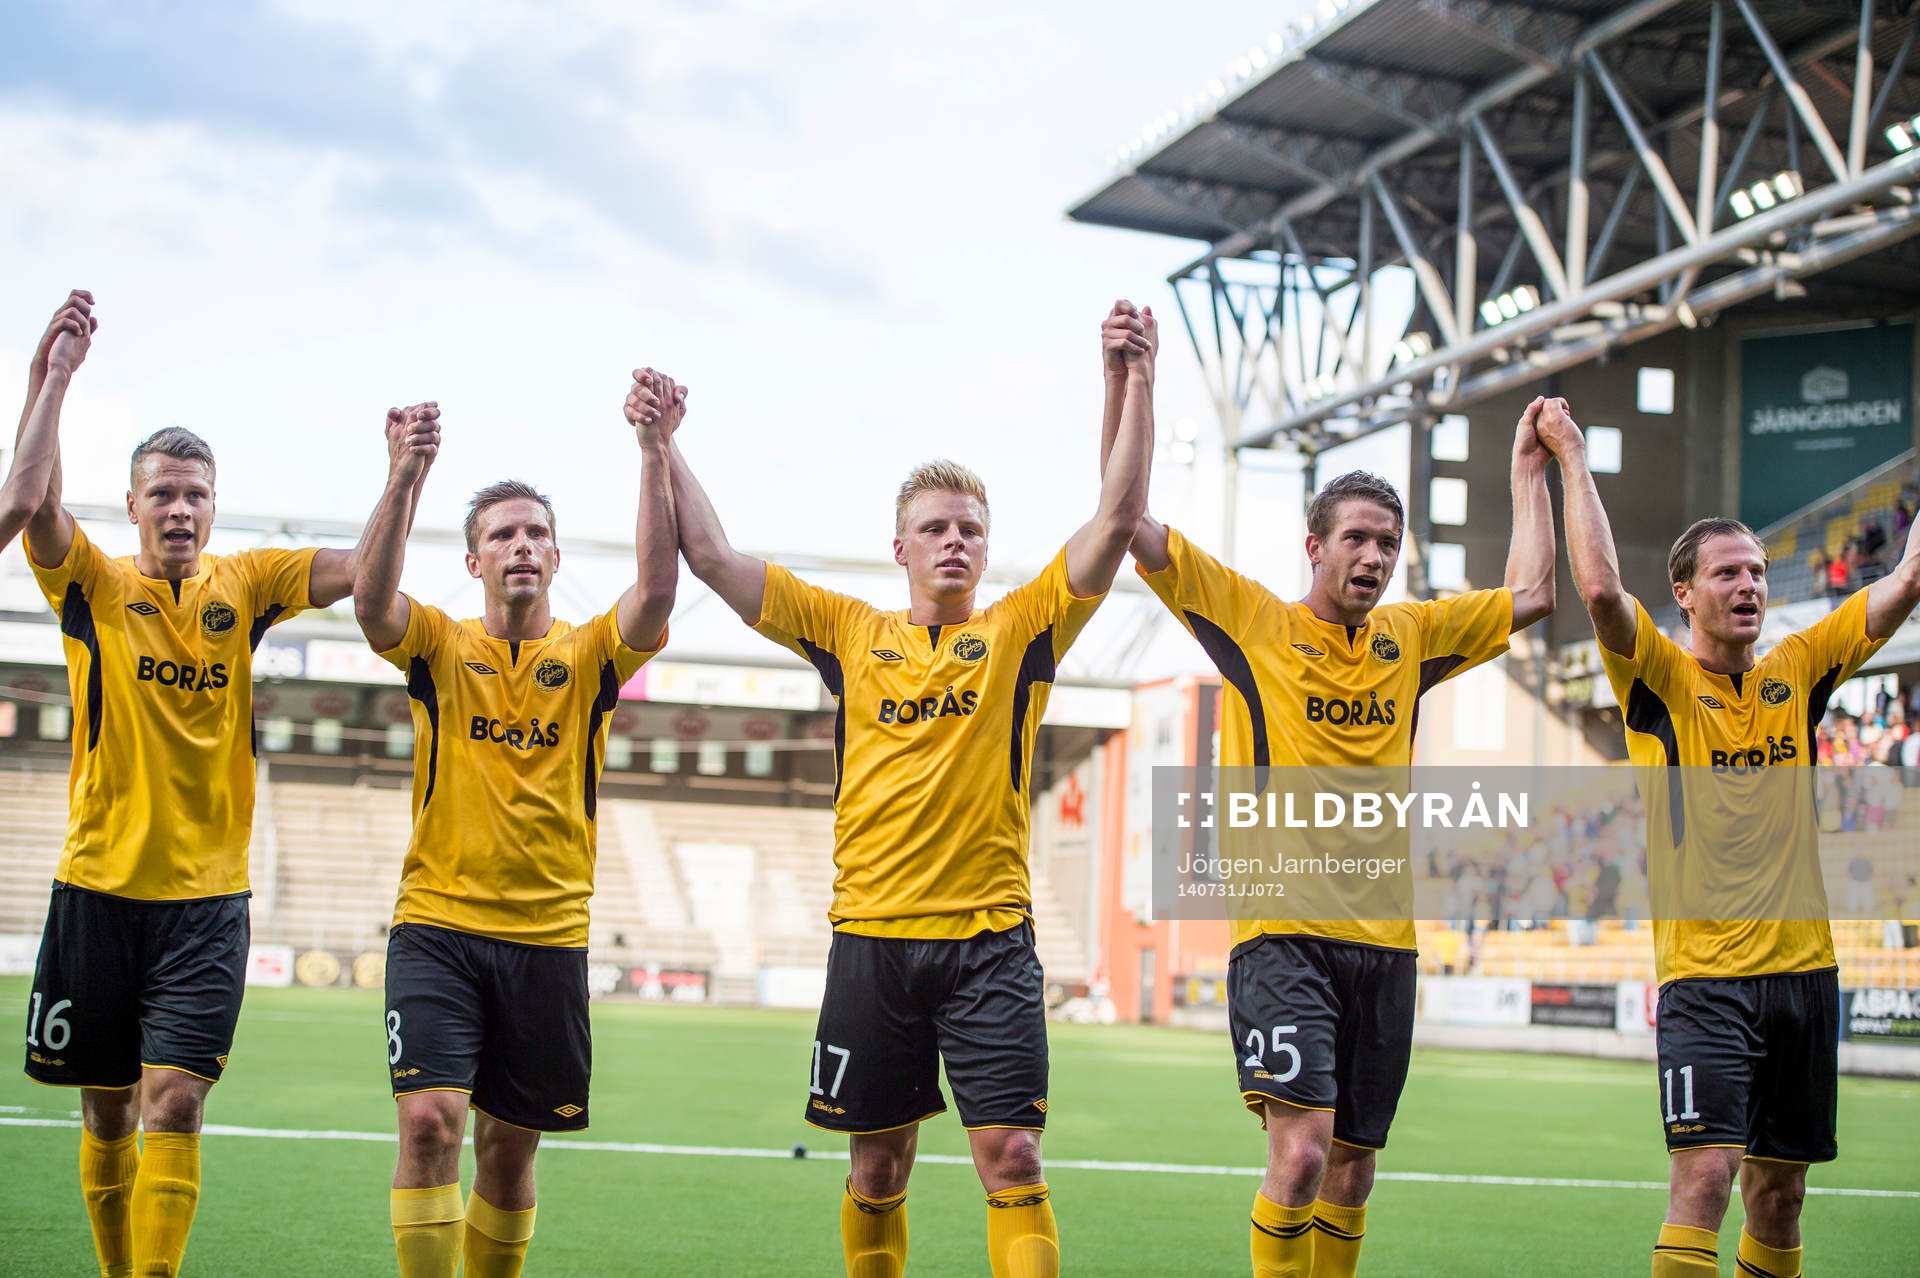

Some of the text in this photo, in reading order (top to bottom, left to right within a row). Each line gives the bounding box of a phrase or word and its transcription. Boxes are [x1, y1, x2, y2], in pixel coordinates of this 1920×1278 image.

[137, 655, 229, 691] BORÅS
[878, 685, 978, 724] BORÅS
[1306, 691, 1396, 726] BORÅS
[469, 716, 560, 751] BORÅS
[1711, 736, 1797, 776] BORÅS
[28, 992, 73, 1050] 16
[387, 1010, 403, 1065] 8
[810, 1041, 850, 1099] 17
[1245, 1025, 1301, 1083] 25
[1664, 1065, 1700, 1123] 11
